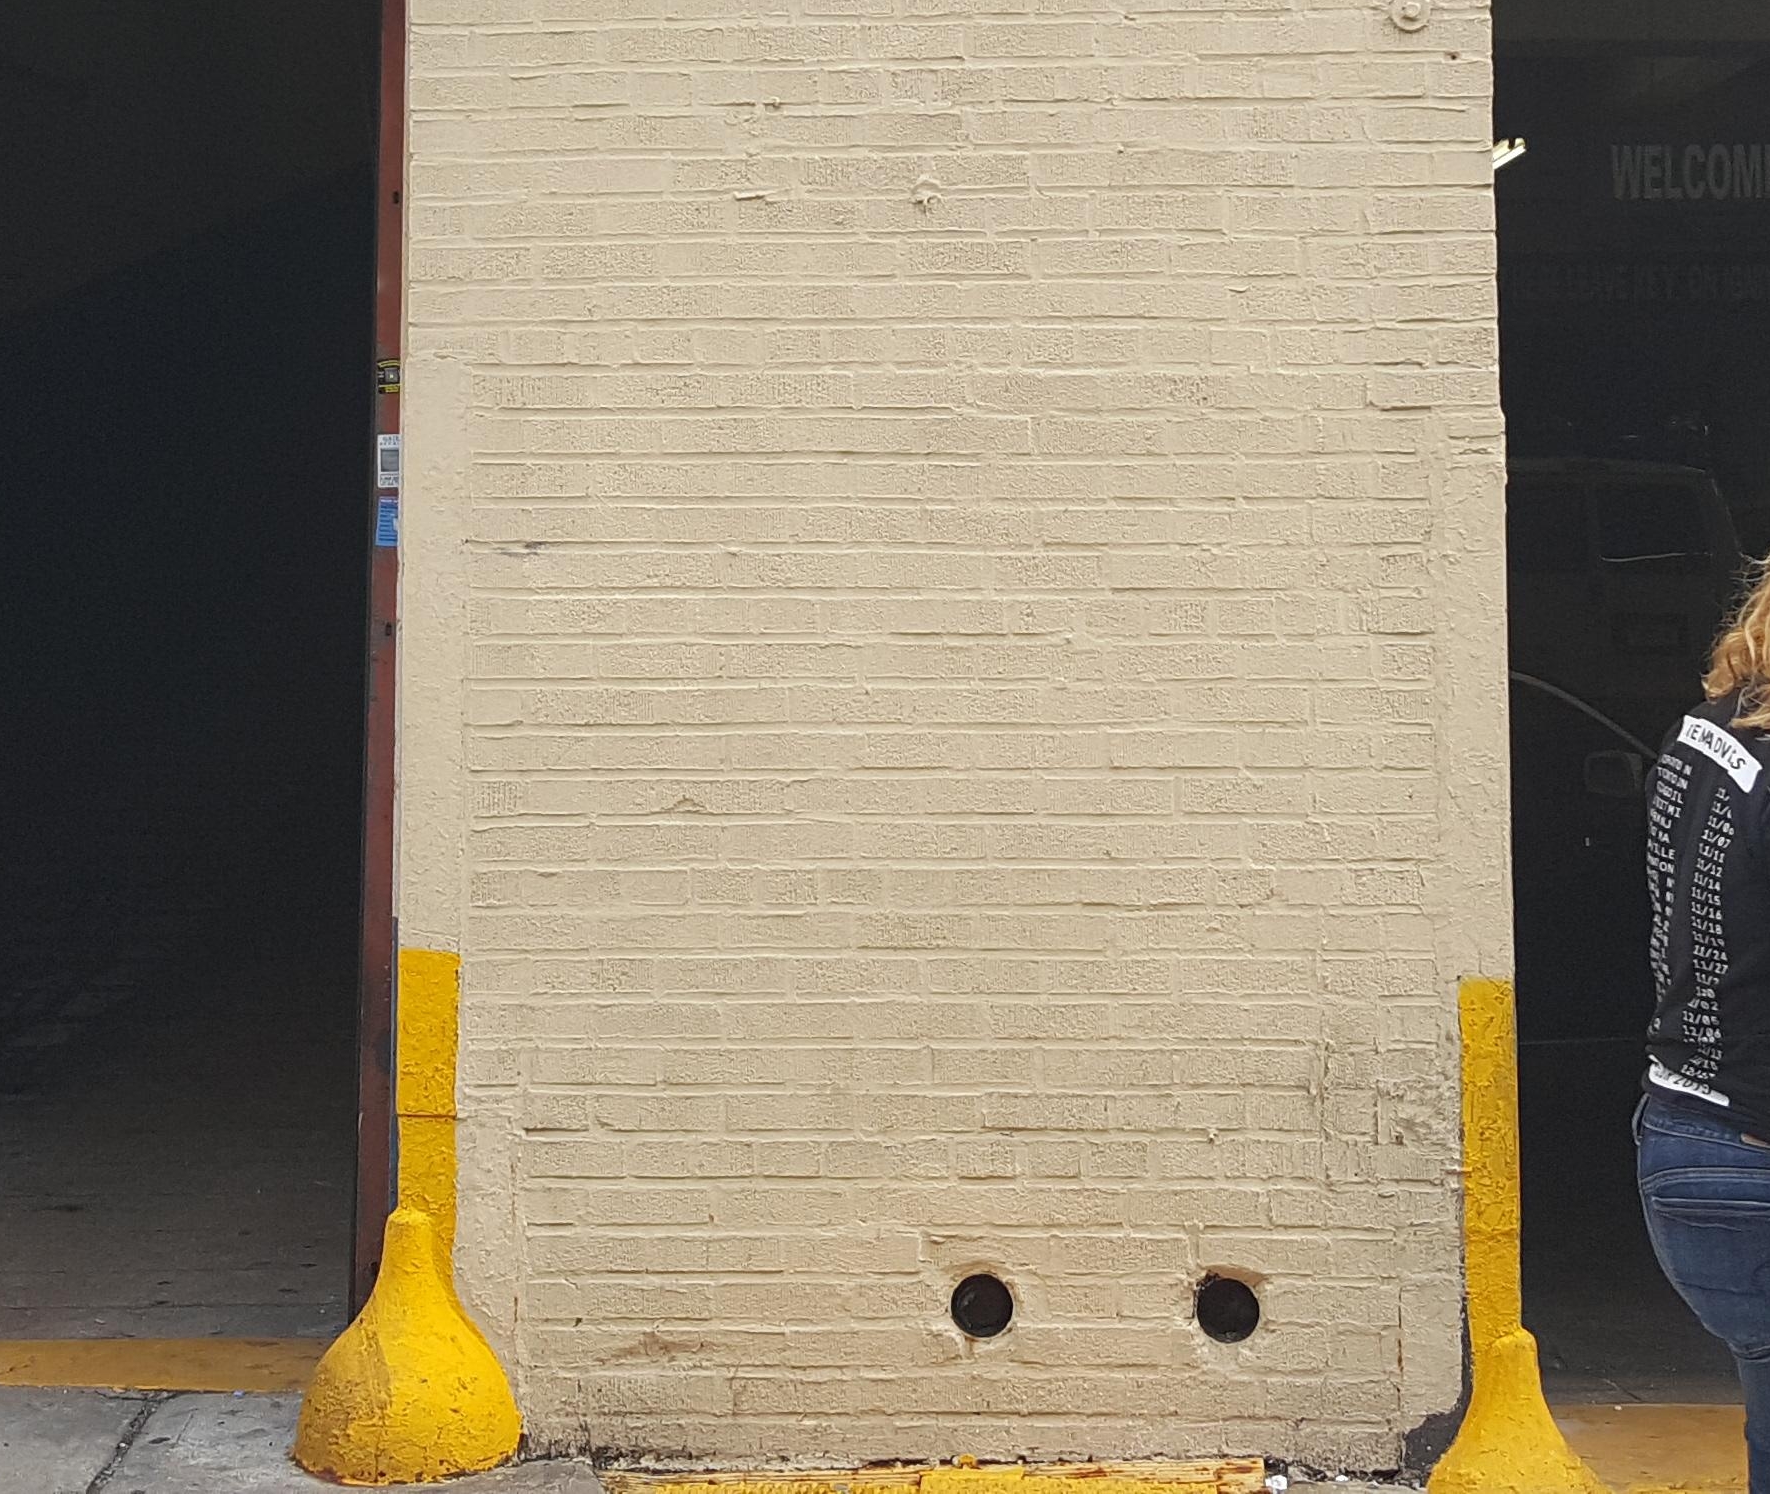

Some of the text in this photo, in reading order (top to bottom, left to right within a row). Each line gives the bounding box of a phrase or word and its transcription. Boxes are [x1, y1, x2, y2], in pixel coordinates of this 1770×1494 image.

[1696, 858, 1723, 878] 11/12
[1694, 872, 1722, 892] 11/14
[1691, 886, 1722, 907] 11/15
[1693, 959, 1729, 975] 11/27
